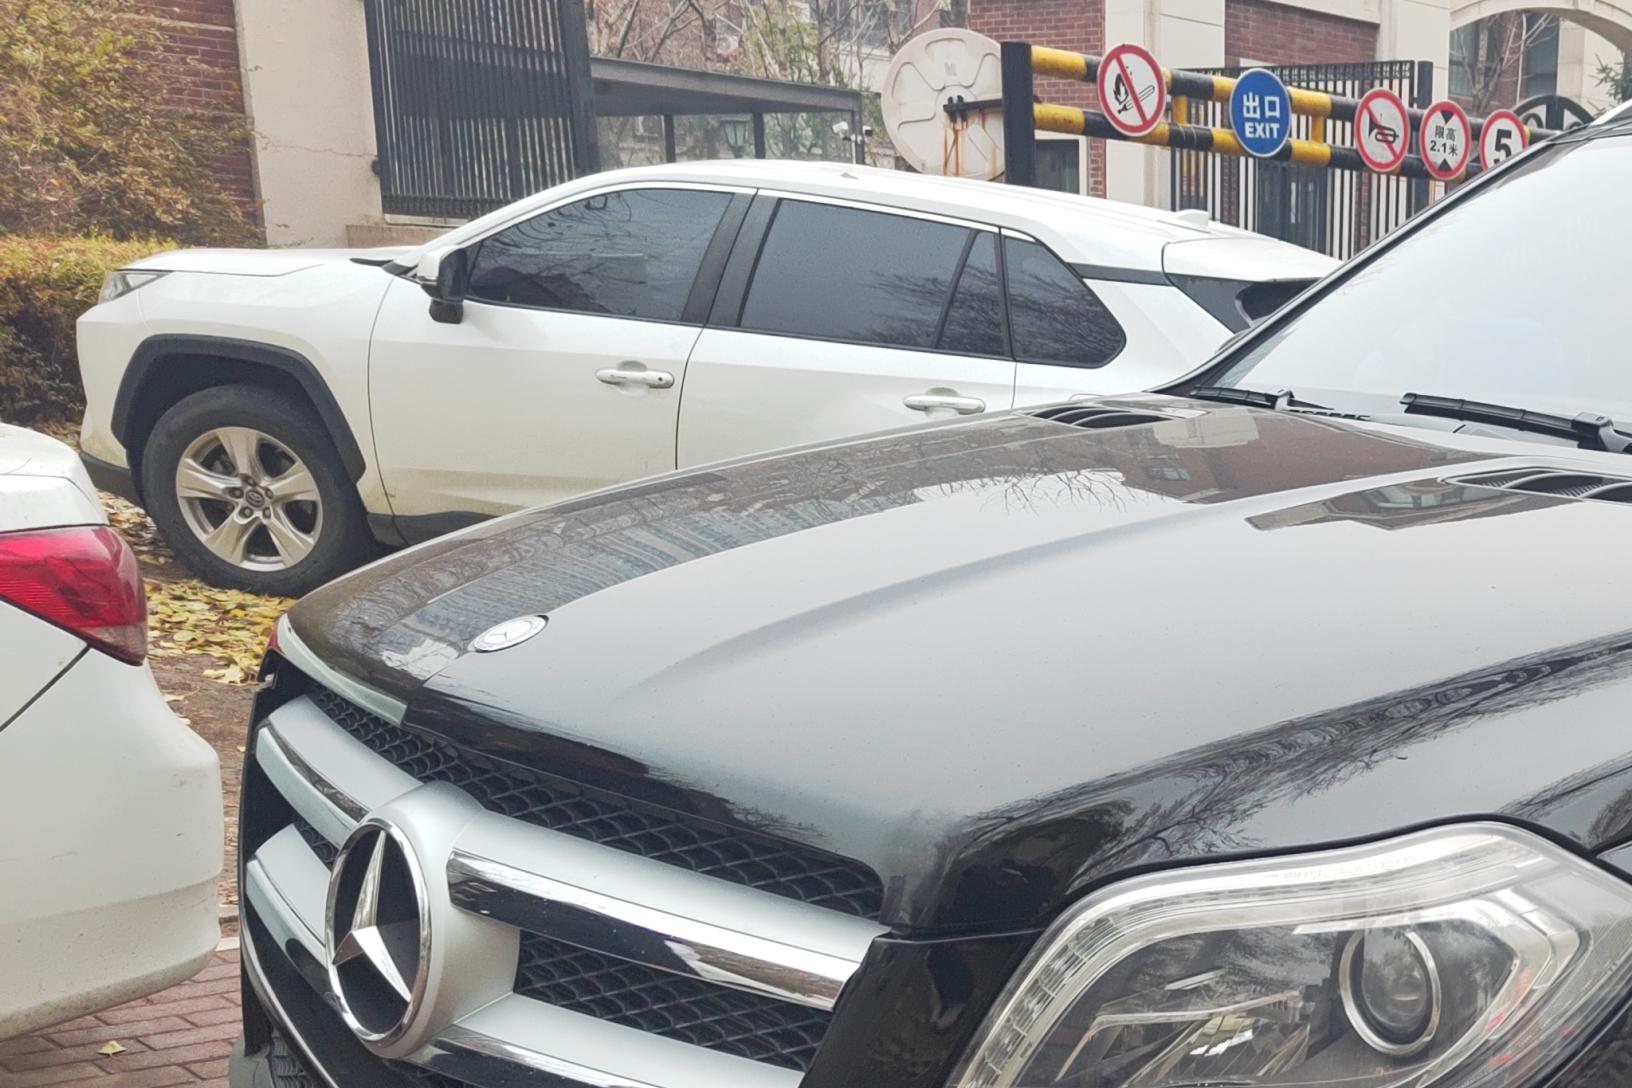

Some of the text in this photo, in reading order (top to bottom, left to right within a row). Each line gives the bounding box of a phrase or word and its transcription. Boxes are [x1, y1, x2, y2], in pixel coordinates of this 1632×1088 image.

[1243, 91, 1280, 119] 出口
[1244, 121, 1280, 139] EXIT
[1434, 124, 1457, 142] 限高
[1429, 140, 1459, 157] 2.1米
[1494, 128, 1513, 165] 5
